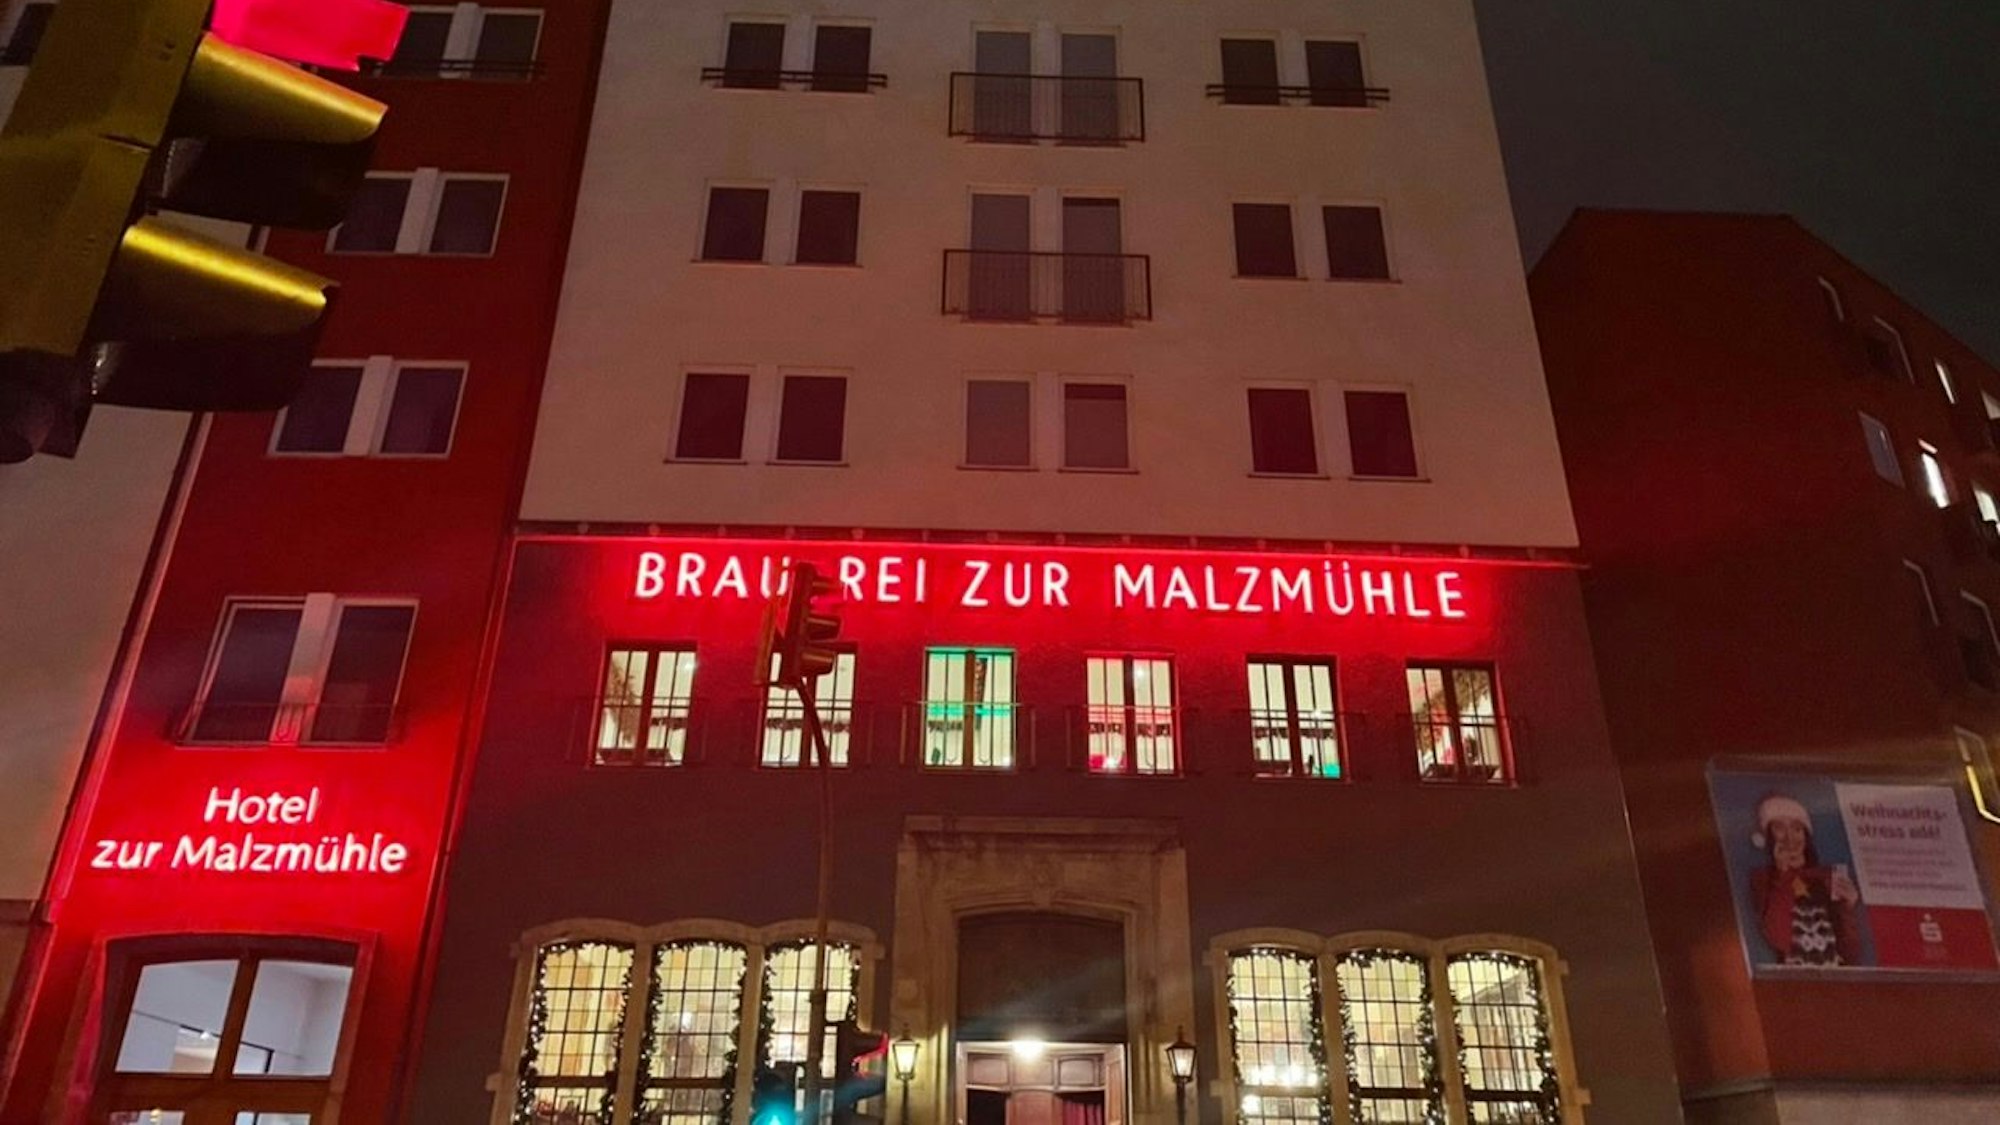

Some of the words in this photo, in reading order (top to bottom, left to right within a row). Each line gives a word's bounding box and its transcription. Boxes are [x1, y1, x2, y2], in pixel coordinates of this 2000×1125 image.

[634, 550, 926, 602] BRAUREI
[961, 560, 1070, 608] ZUR
[1113, 560, 1466, 618] MALZMÜHLE
[203, 786, 319, 824] Hotel
[91, 838, 163, 869] zur
[170, 832, 408, 873] Malzmühle
